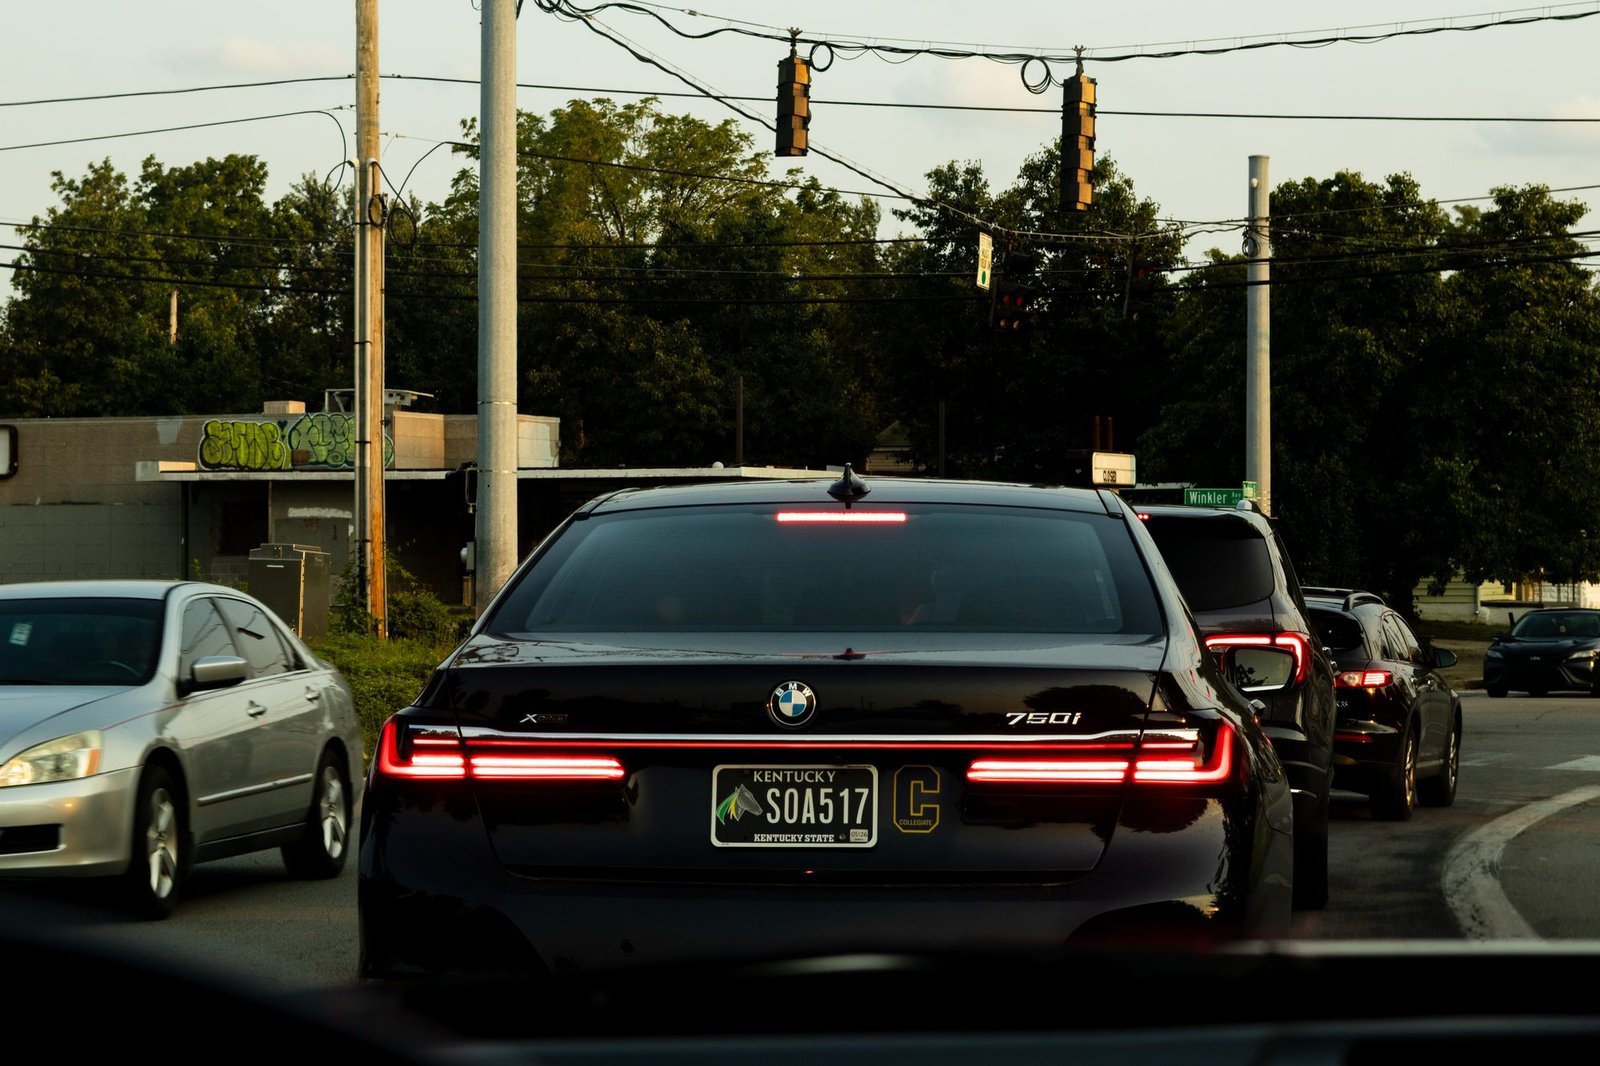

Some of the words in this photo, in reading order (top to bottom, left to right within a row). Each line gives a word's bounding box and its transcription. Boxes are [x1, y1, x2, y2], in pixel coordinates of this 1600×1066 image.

[1103, 470, 1117, 482] CLOSED
[1189, 491, 1227, 504] Winkler
[775, 682, 812, 697] BMW
[1005, 712, 1082, 725] 750i
[753, 770, 836, 783] KENTUCKY
[893, 764, 941, 833] C
[766, 788, 869, 824] SOA517
[753, 833, 799, 842] KENTUCKY
[801, 833, 835, 842] STATE
